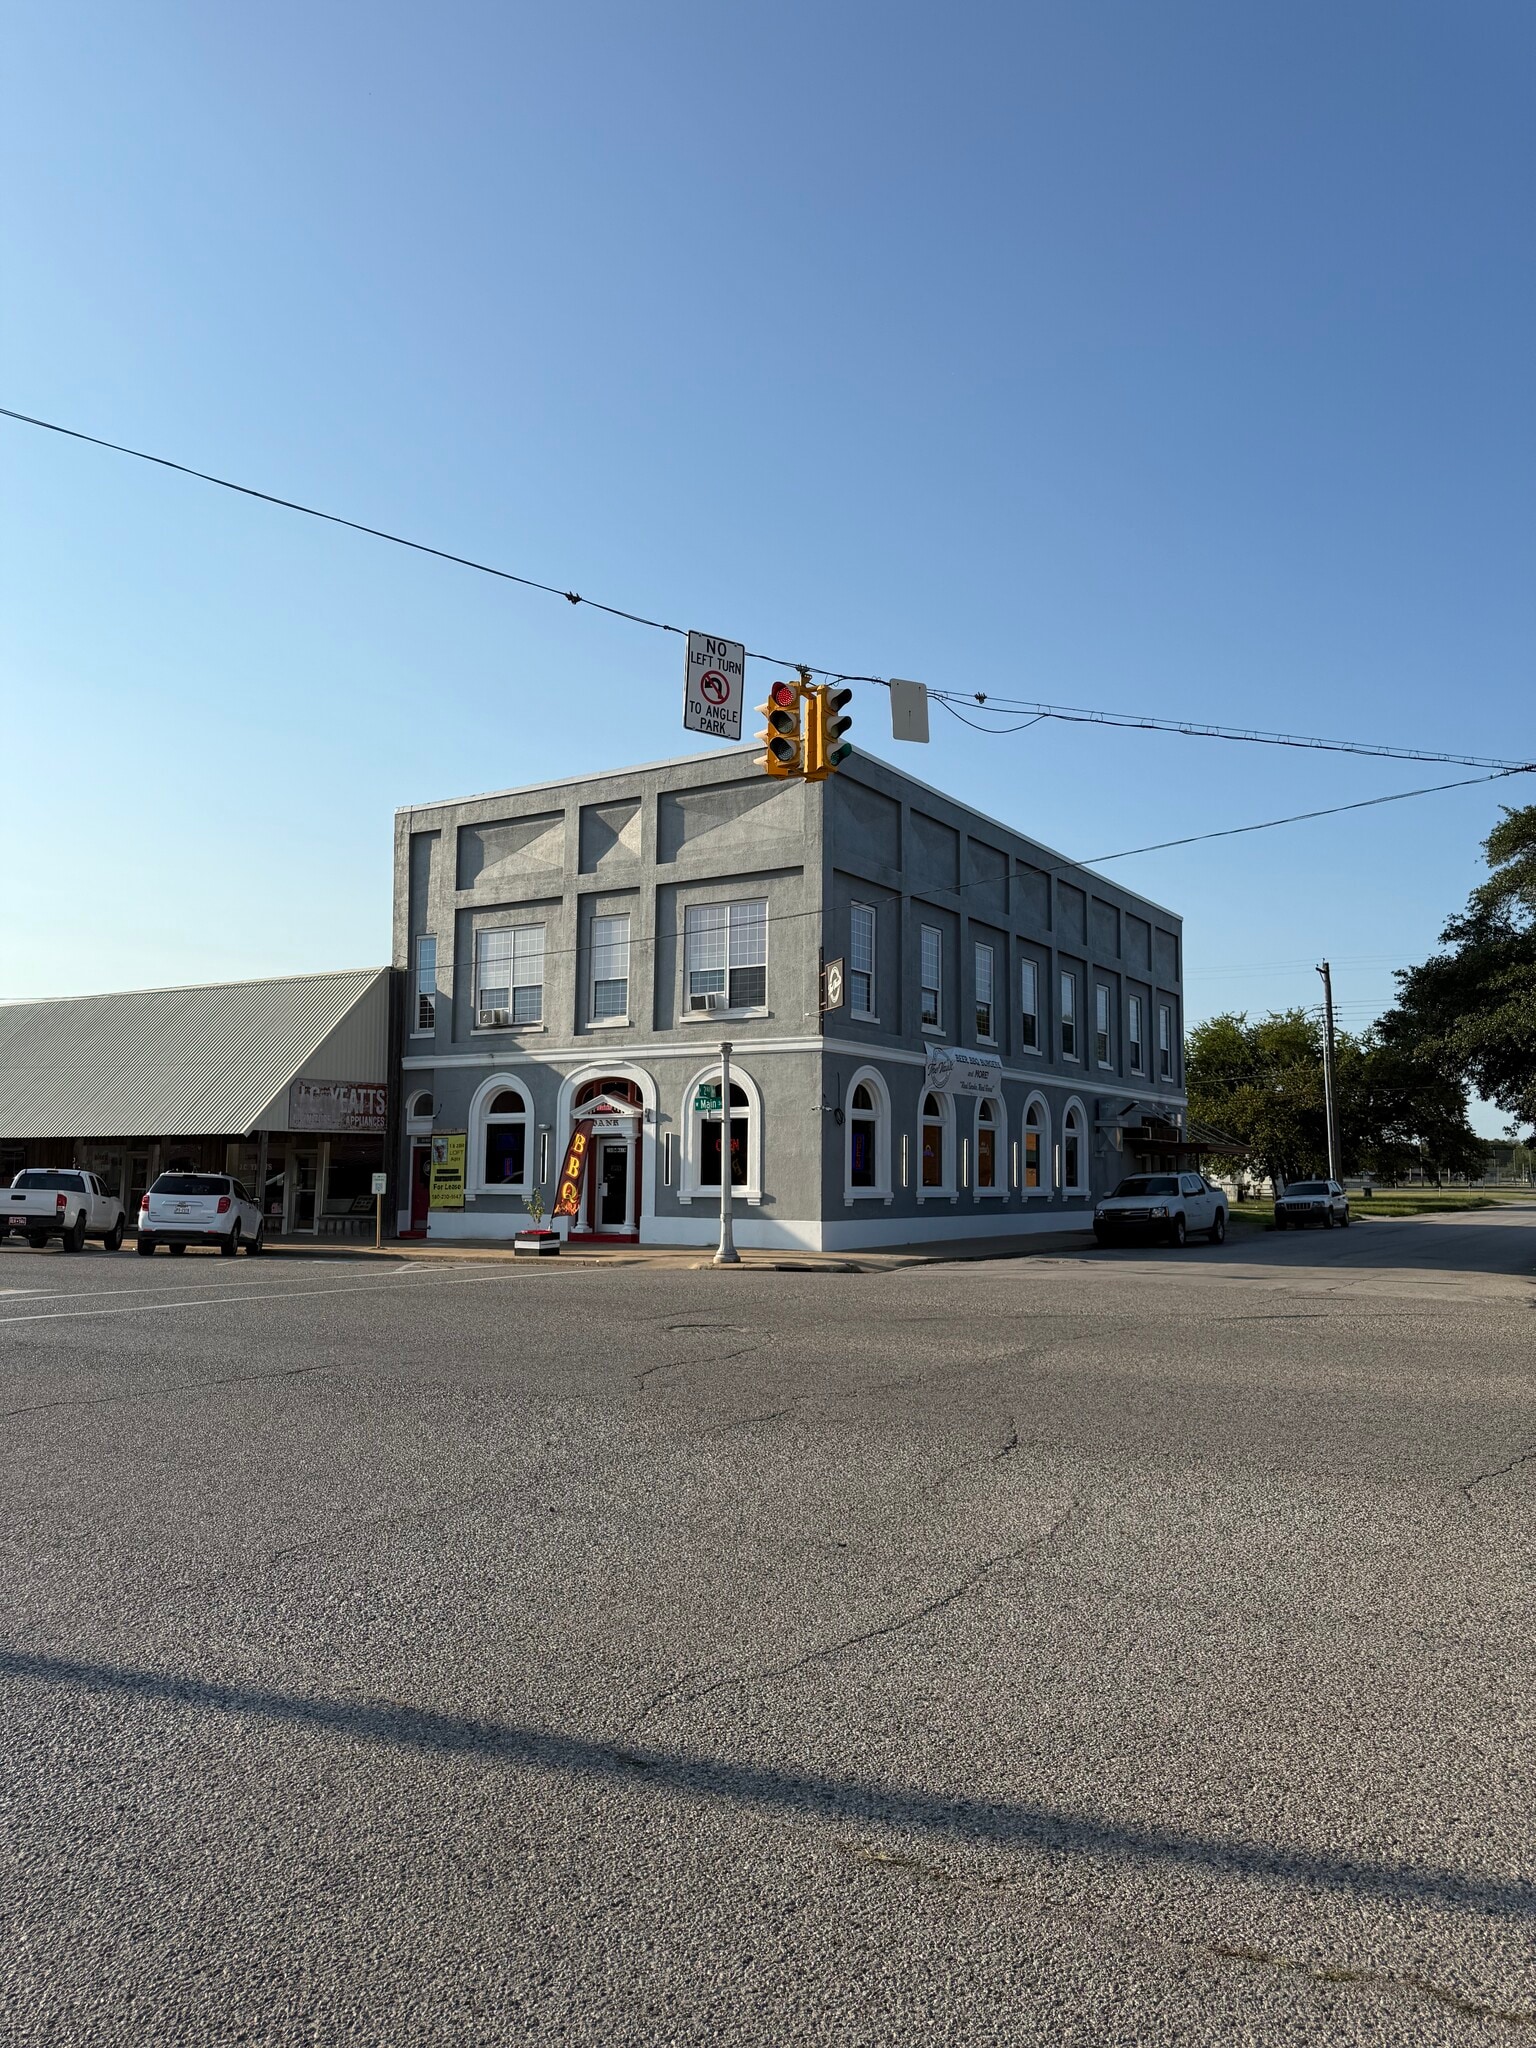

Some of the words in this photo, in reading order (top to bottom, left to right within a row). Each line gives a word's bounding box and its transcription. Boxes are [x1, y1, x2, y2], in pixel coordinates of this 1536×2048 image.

[706, 638, 727, 657] NO
[691, 651, 713, 667] LEFT
[717, 658, 741, 675] TURN
[690, 700, 701, 714] TO
[706, 705, 738, 723] ANGLE
[700, 717, 726, 735] PARK
[330, 1086, 385, 1115] YEATTS
[700, 1099, 717, 1109] Main
[346, 1114, 385, 1127] APPLIANCES
[716, 1138, 739, 1152] OEN
[562, 1133, 586, 1204] BBQ
